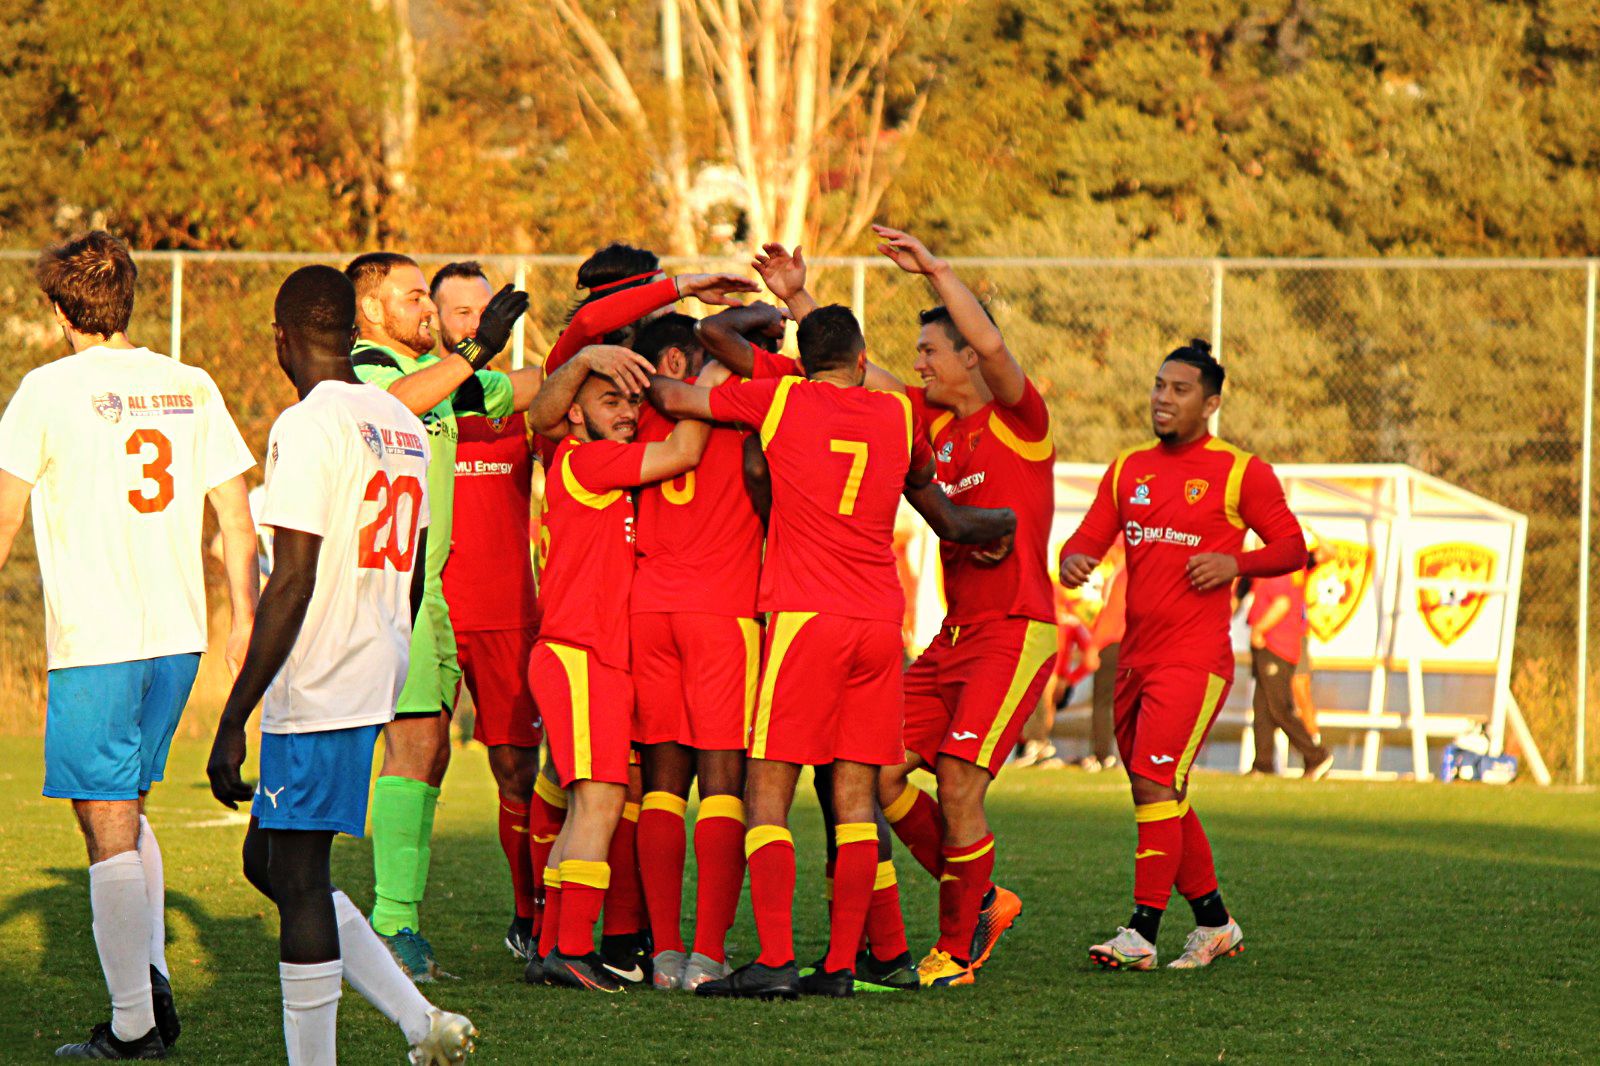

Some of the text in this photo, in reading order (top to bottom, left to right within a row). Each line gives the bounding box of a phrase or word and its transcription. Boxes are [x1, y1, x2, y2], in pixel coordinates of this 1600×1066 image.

[128, 394, 193, 409] ALL STATES
[125, 429, 174, 513] 3
[475, 460, 513, 474] Energy
[830, 439, 868, 515] 7
[358, 470, 423, 572] 20
[1143, 527, 1163, 541] EMU
[1165, 527, 1202, 546] Energy
